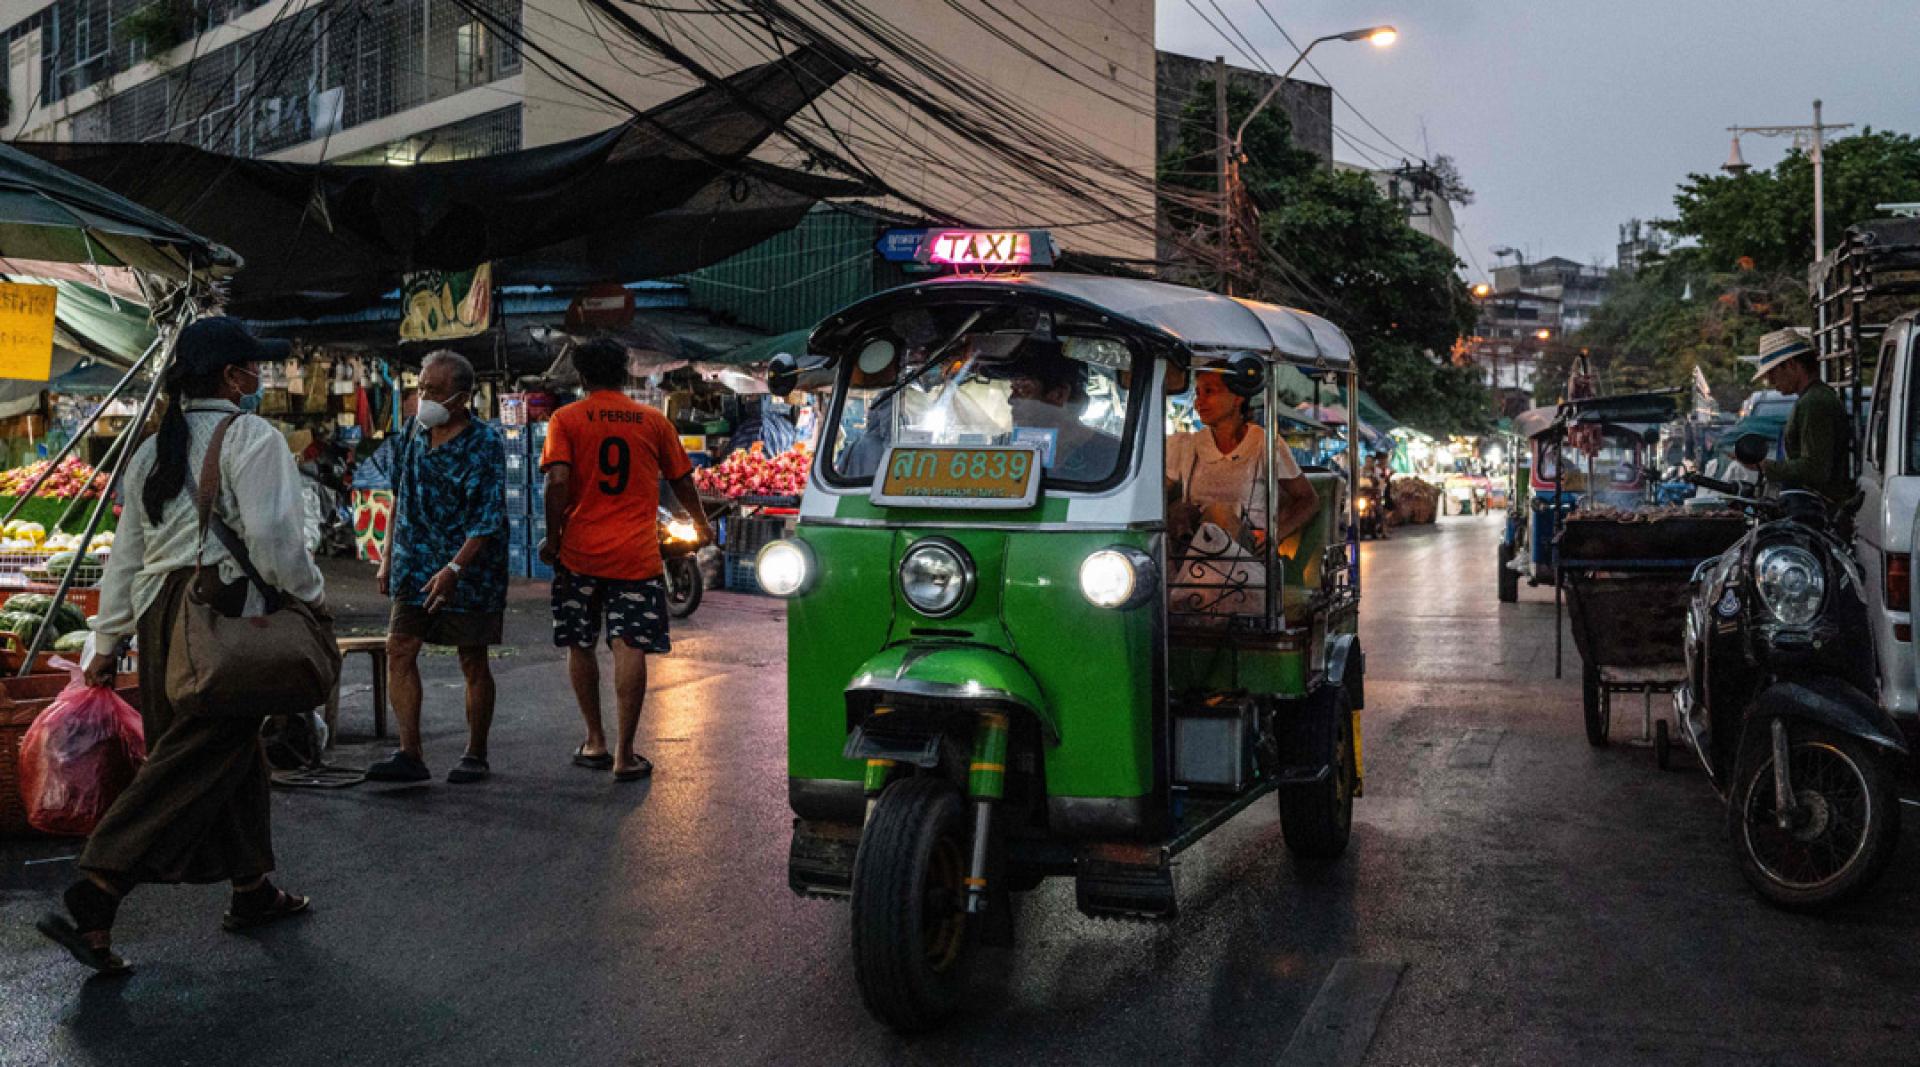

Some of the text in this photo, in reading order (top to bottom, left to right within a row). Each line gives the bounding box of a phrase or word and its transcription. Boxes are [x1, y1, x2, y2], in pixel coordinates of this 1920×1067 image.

[942, 233, 1018, 260] TAXI
[600, 409, 644, 424] PERSIE
[598, 436, 630, 496] 9
[894, 450, 1027, 480] สก 6839
